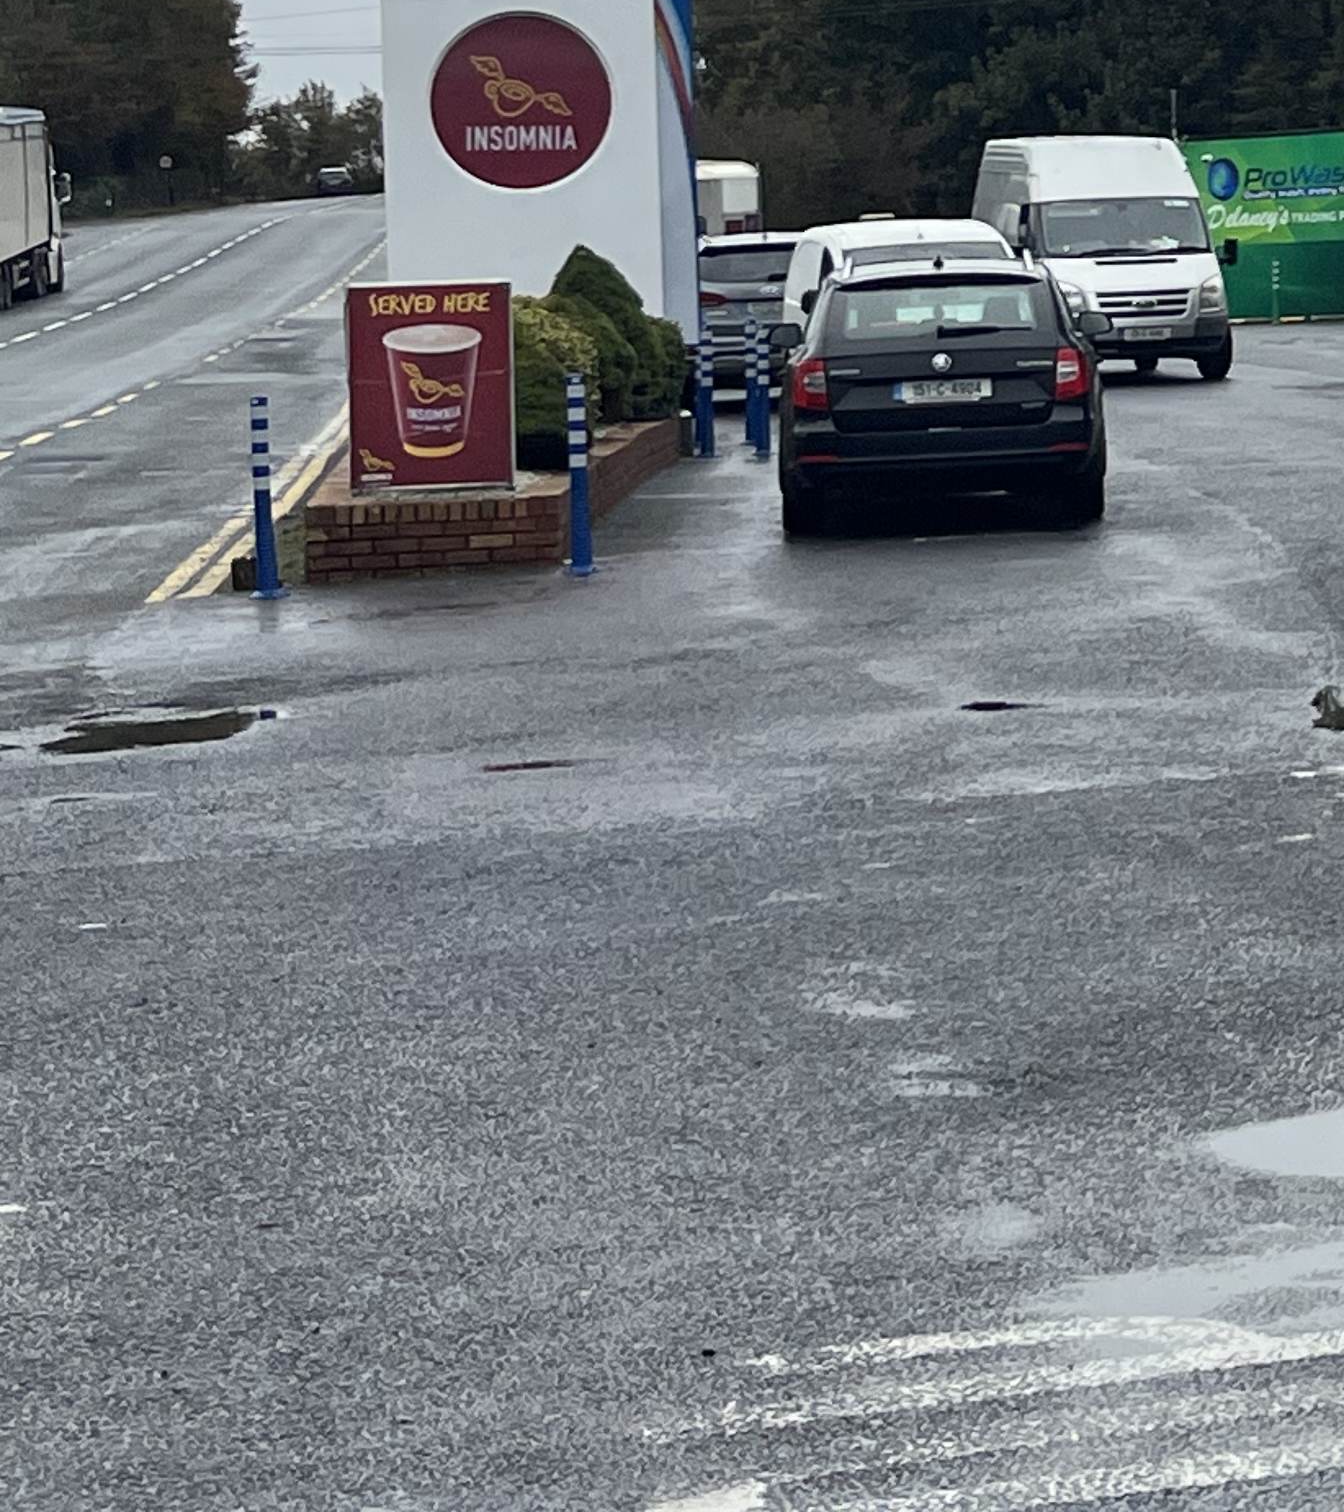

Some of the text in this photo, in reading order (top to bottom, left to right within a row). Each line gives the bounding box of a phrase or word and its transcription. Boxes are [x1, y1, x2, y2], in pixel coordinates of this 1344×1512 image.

[465, 124, 578, 152] INSOMNIA
[369, 291, 491, 317] SERVED HERE
